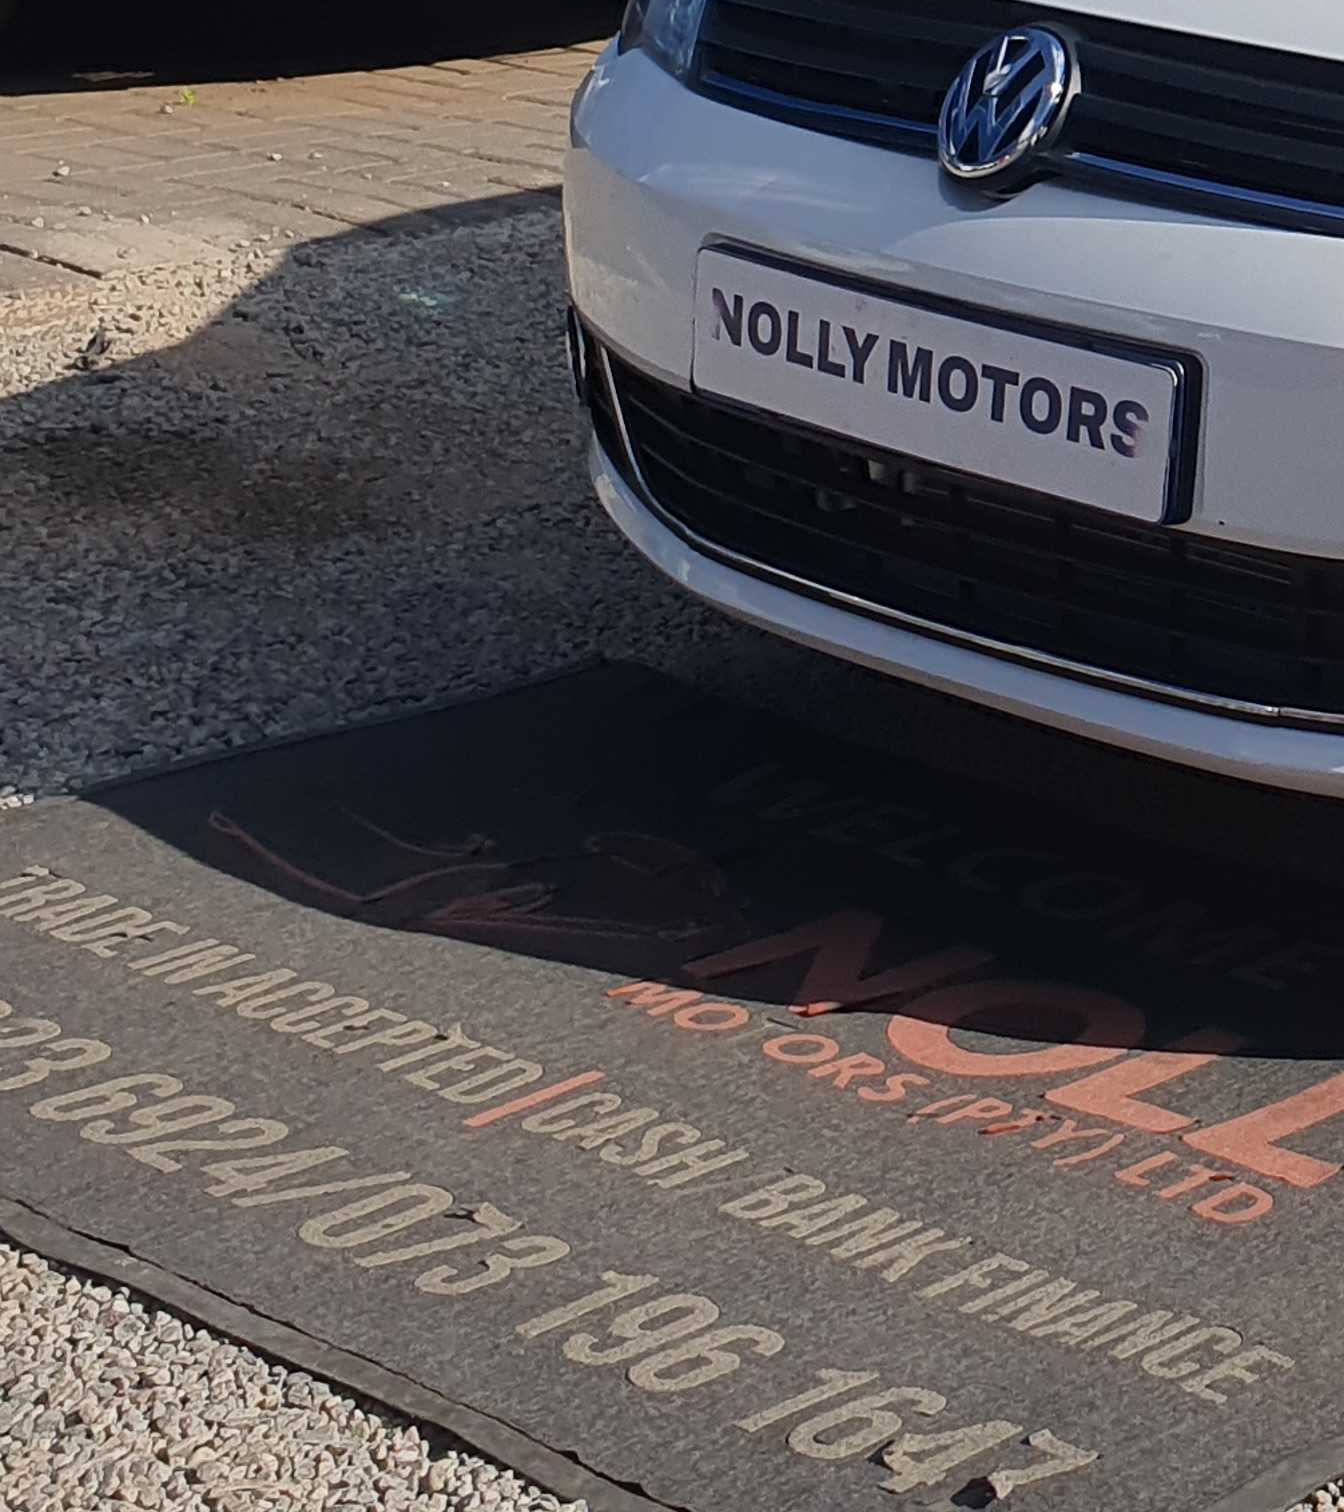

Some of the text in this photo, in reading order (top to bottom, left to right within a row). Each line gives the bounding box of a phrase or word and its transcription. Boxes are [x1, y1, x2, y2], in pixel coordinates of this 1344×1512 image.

[711, 287, 1150, 459] NOLLY MOTORS
[0, 865, 191, 958] TRADE
[127, 938, 257, 985] IN
[192, 967, 545, 1105] ACCEPTED
[718, 1173, 970, 1284] BANK
[918, 1251, 1296, 1404] FINANCE
[605, 980, 931, 1103] MOORS
[1114, 1150, 1275, 1224] LTD
[29, 1072, 1101, 1500] 6924/073 196 1647
